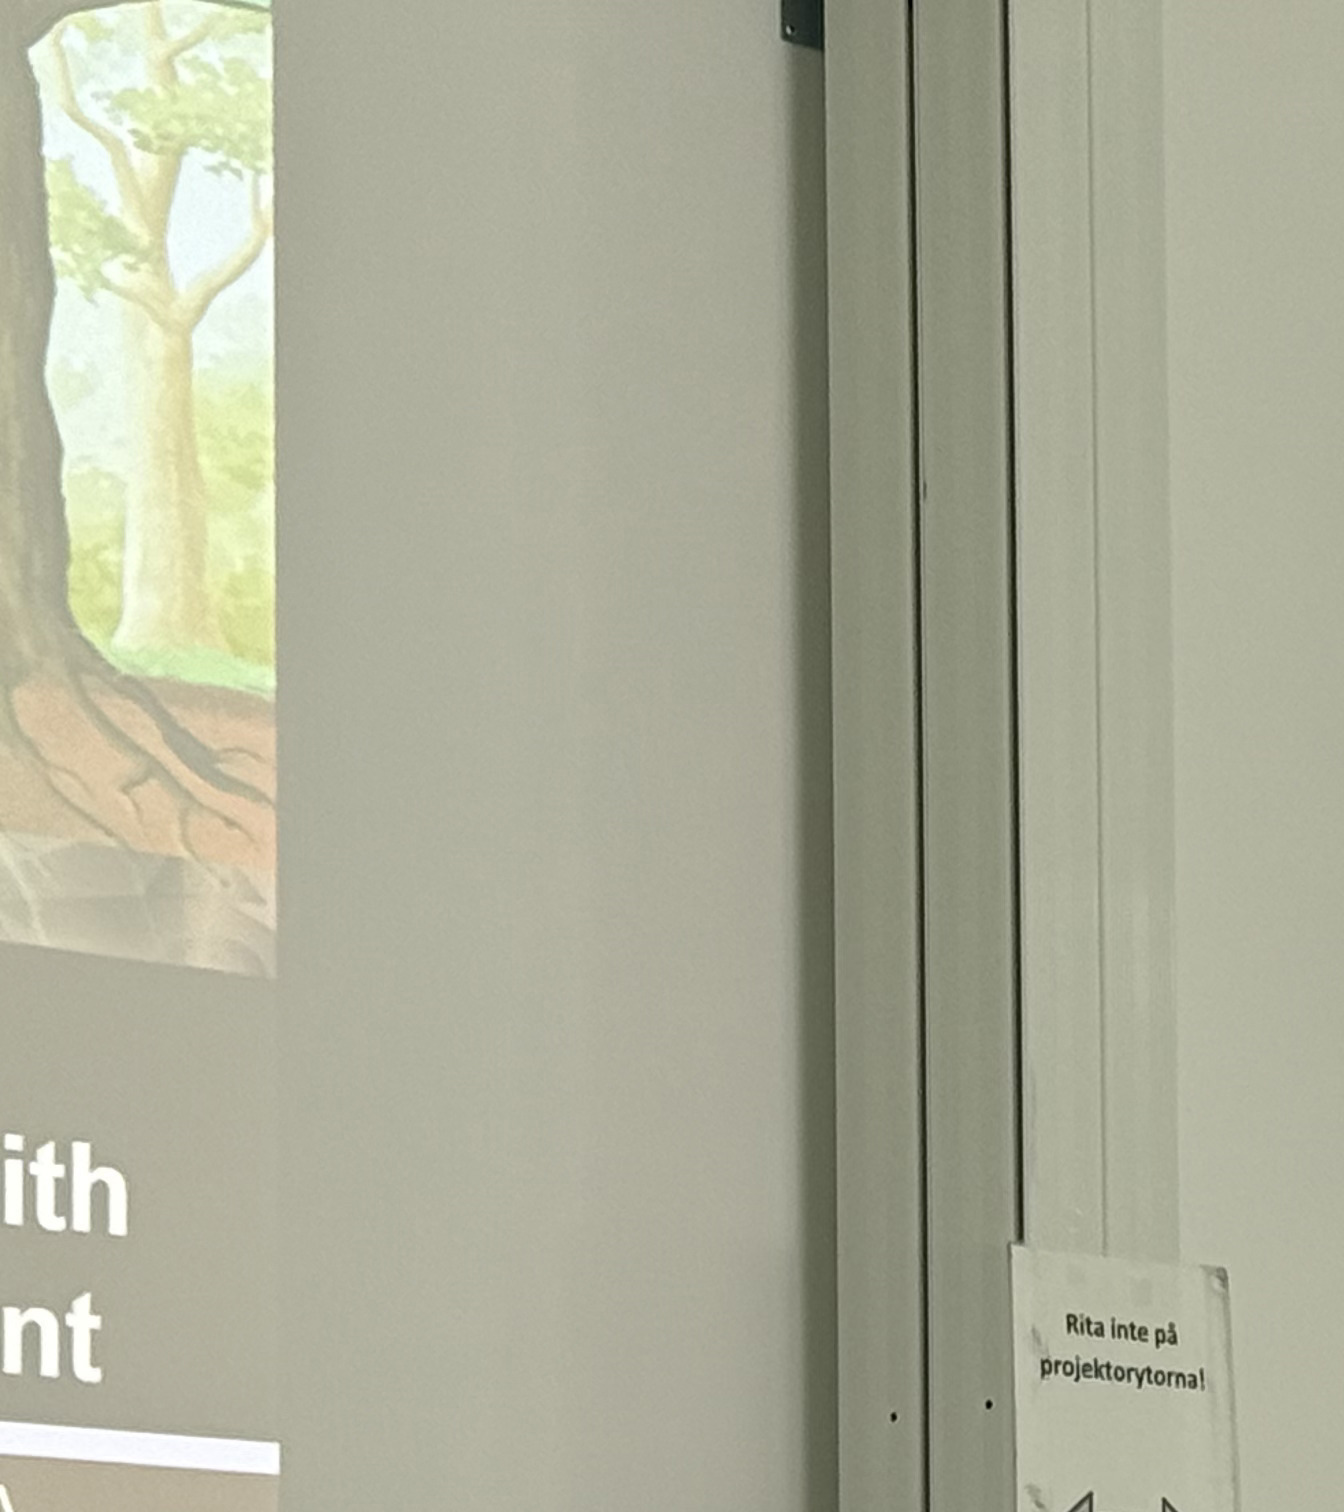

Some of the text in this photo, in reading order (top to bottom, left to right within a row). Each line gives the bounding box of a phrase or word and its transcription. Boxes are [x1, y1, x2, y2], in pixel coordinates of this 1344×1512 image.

[2, 1133, 128, 1237] ith
[1, 1291, 102, 1383] nt
[1066, 1313, 1178, 1348] Rita inte på
[1040, 1355, 1206, 1391] projektorytorna!
